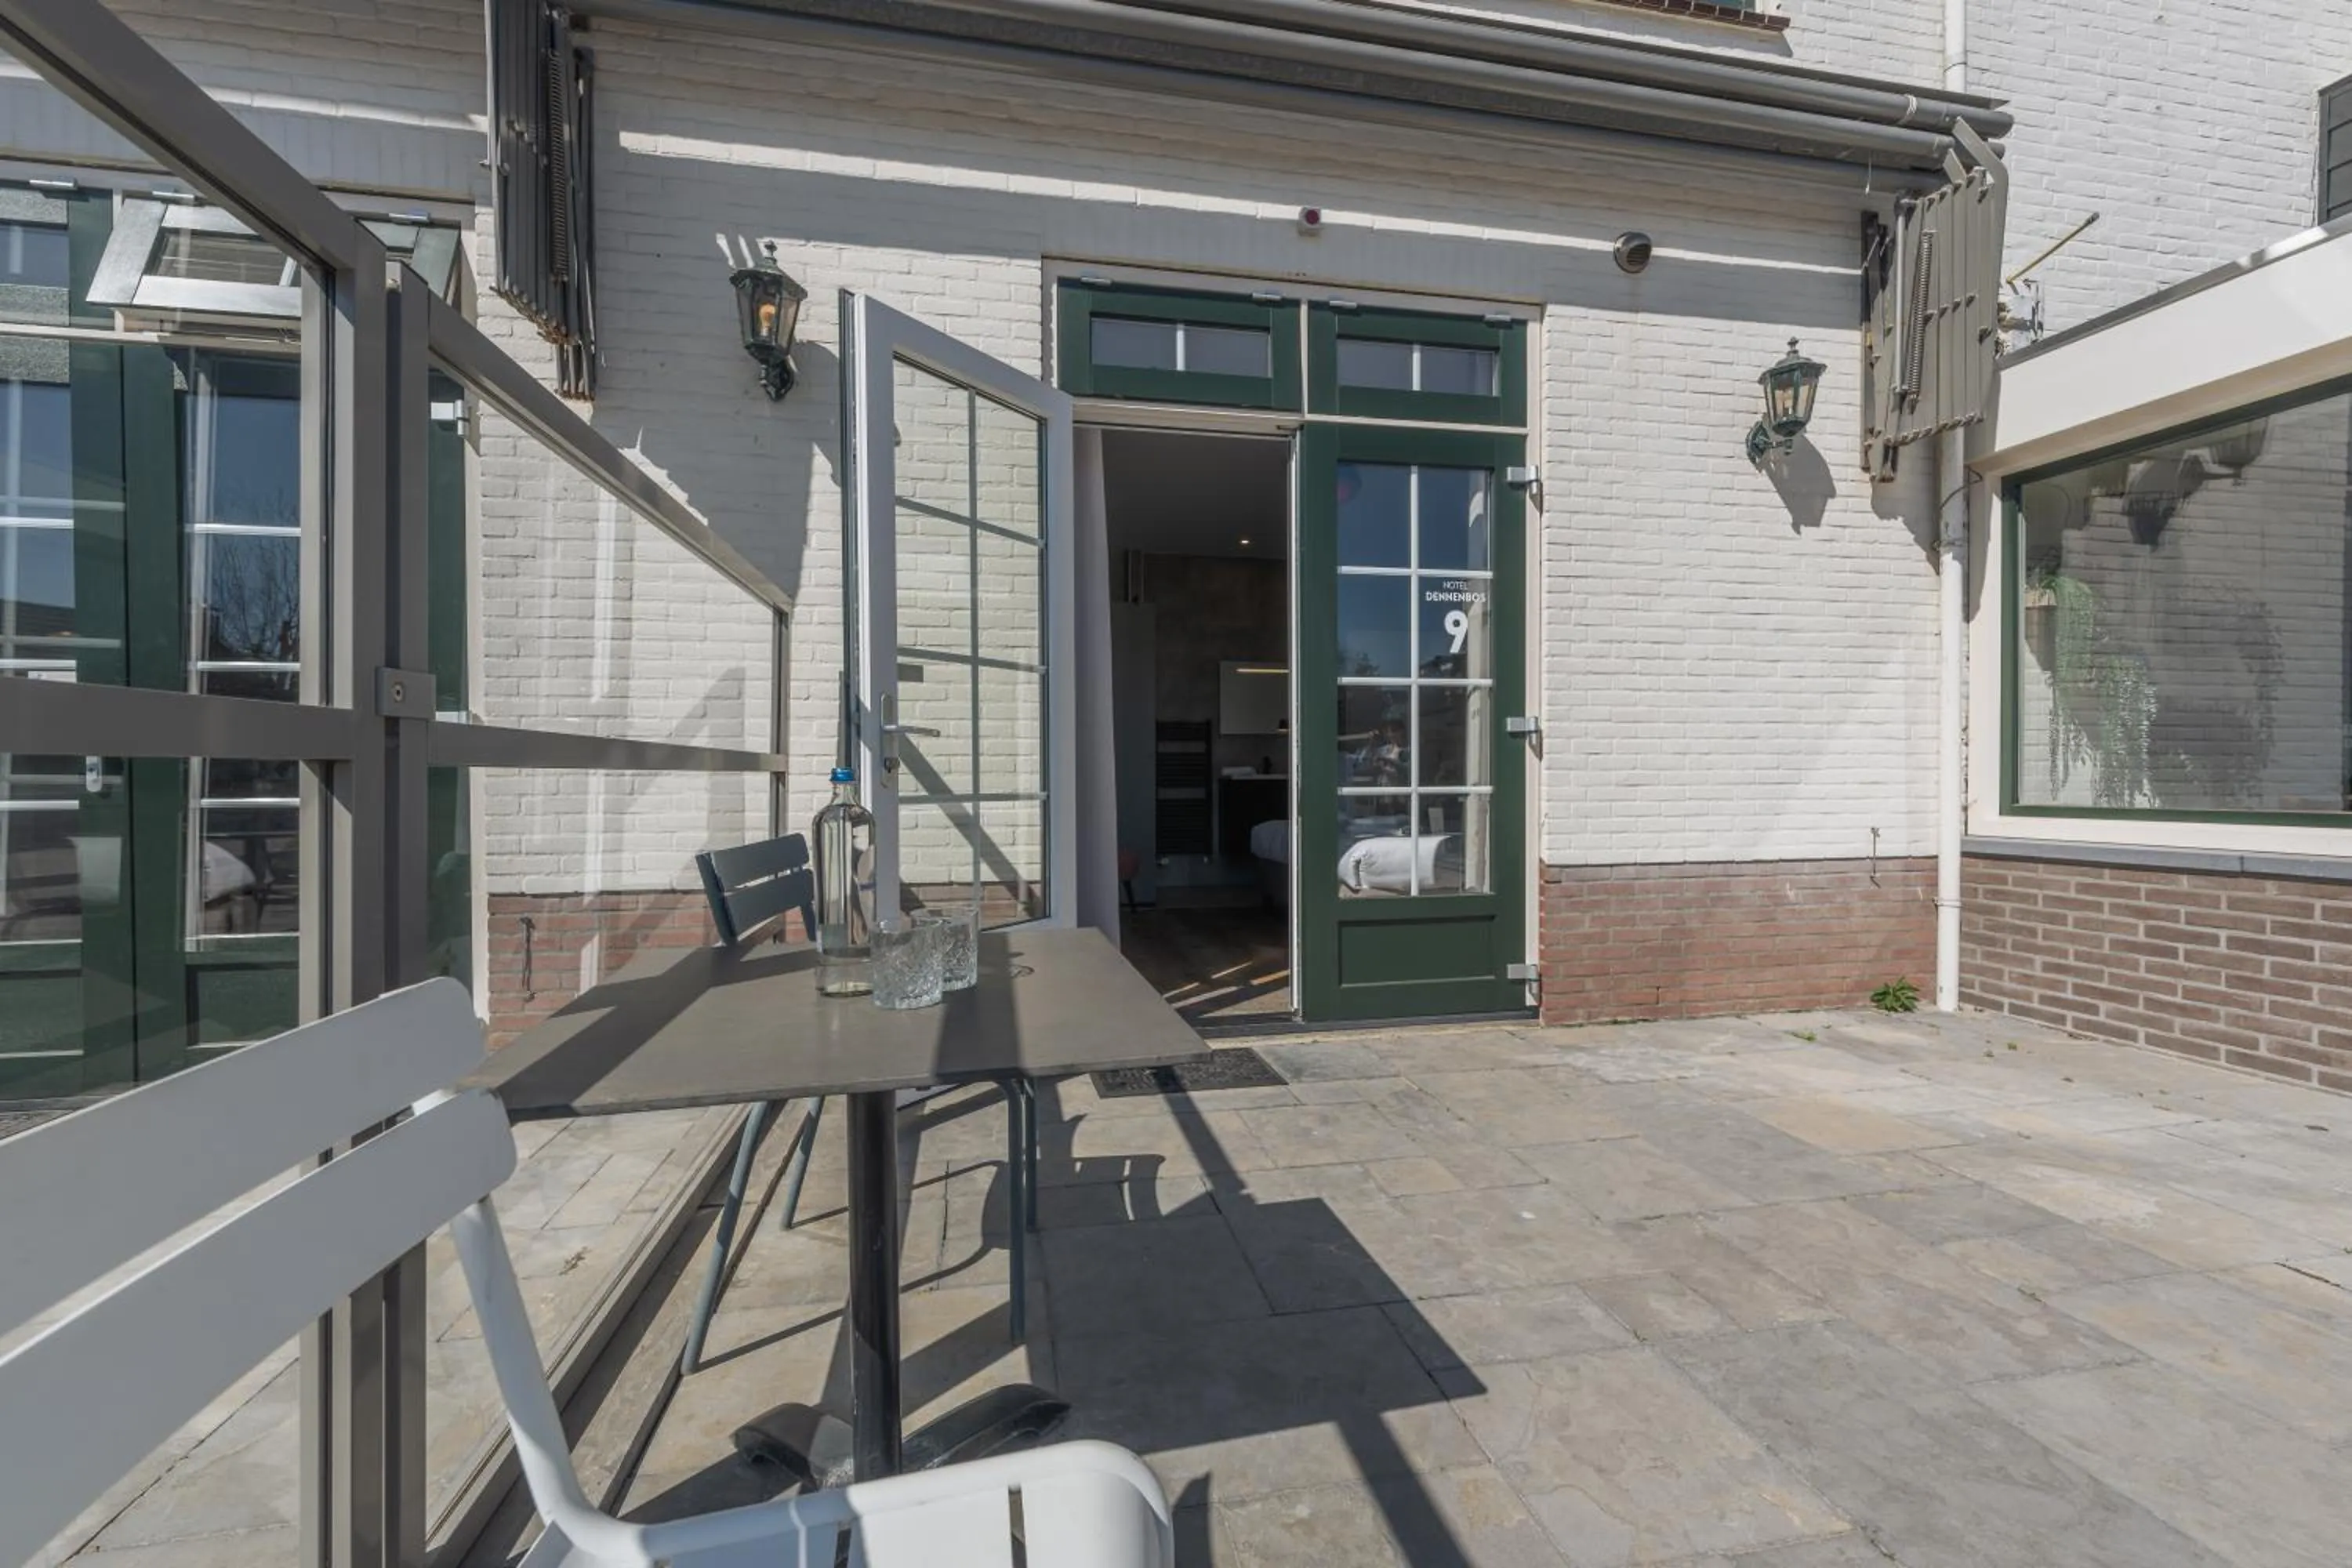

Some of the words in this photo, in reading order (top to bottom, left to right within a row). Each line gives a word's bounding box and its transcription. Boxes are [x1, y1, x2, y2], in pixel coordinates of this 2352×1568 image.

[1443, 581, 1468, 590] HOTEL
[1425, 592, 1486, 602] DENNENBOS
[1444, 610, 1468, 653] 9
